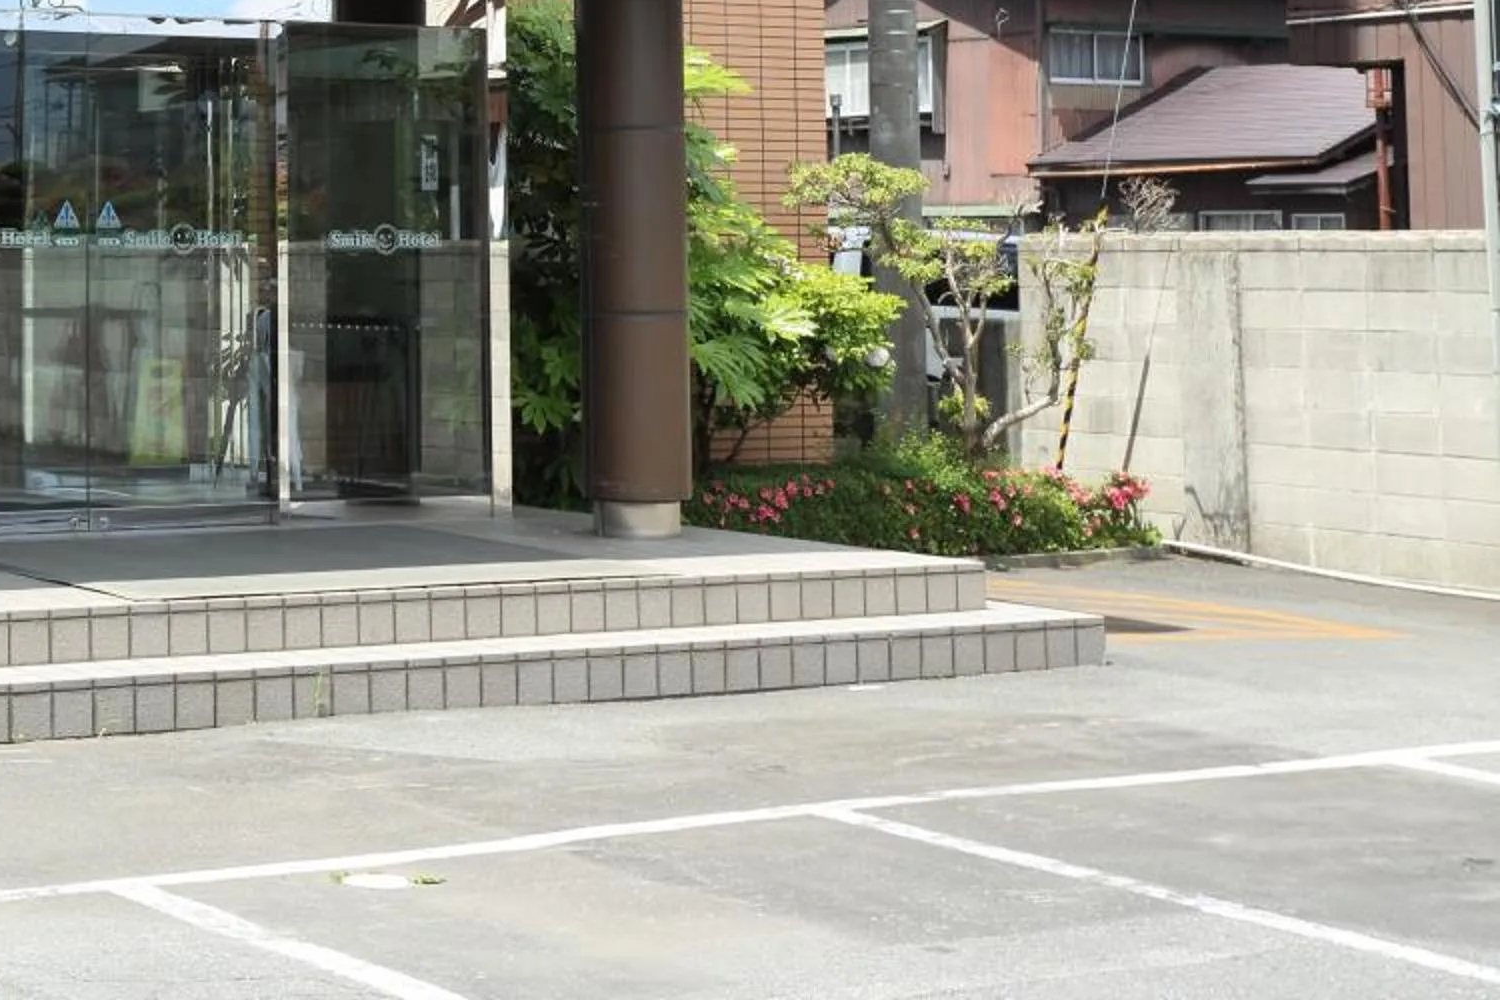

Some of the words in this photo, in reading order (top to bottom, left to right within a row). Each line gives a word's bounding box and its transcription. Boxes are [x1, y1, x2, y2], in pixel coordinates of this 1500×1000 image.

[1, 229, 51, 246] Hotel
[330, 230, 376, 248] Smile
[397, 230, 442, 247] Hotel
